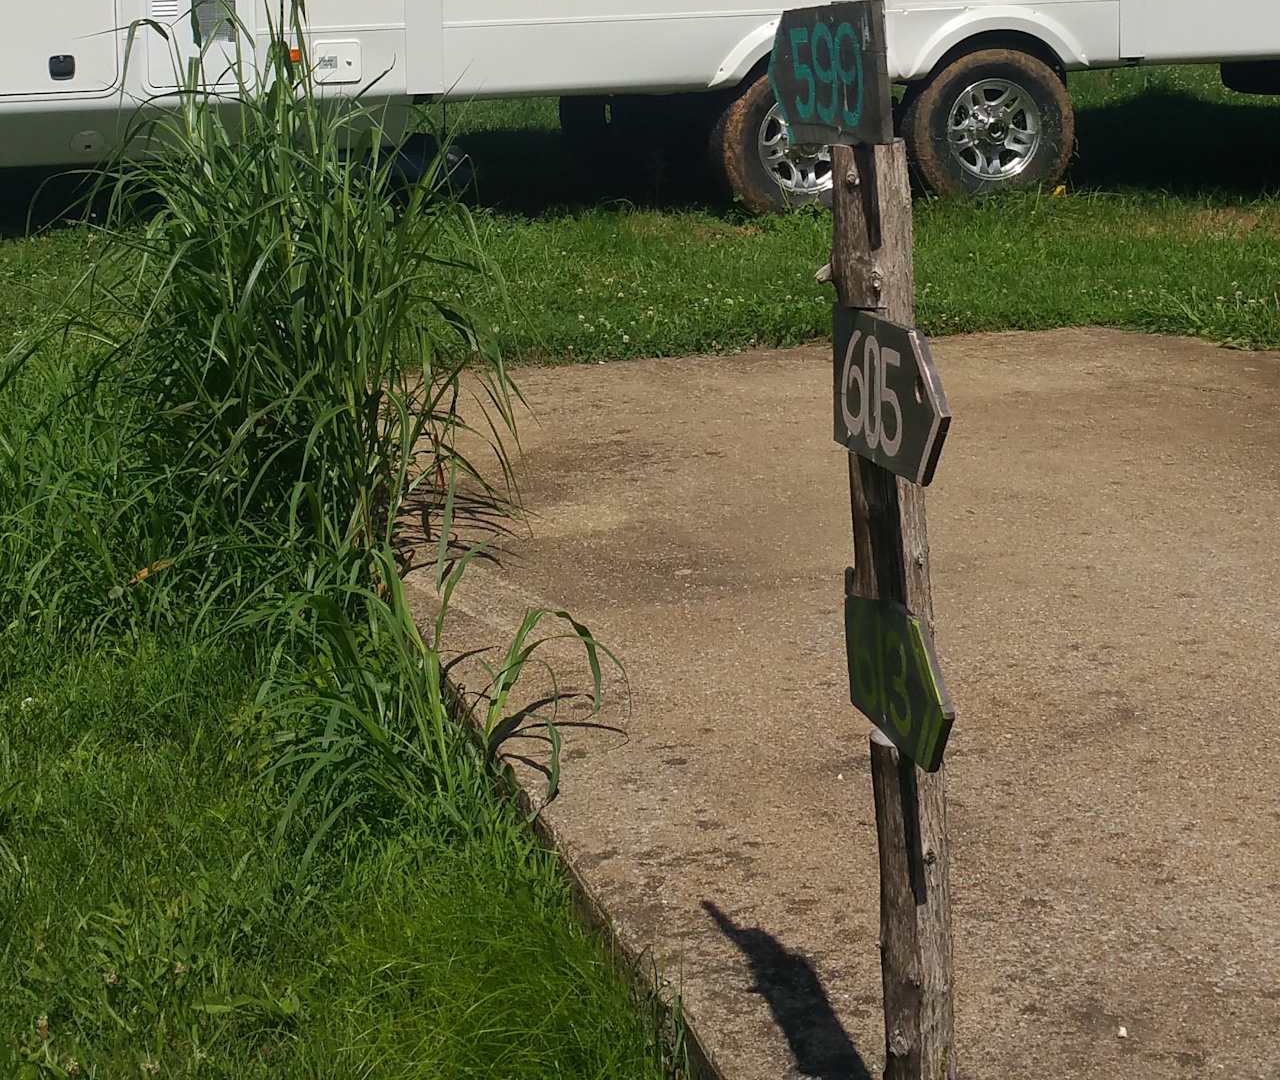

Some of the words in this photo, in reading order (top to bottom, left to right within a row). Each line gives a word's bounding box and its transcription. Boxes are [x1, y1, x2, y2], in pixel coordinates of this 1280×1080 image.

[789, 22, 864, 128] 599
[841, 329, 903, 457] 605
[851, 600, 913, 737] 613
